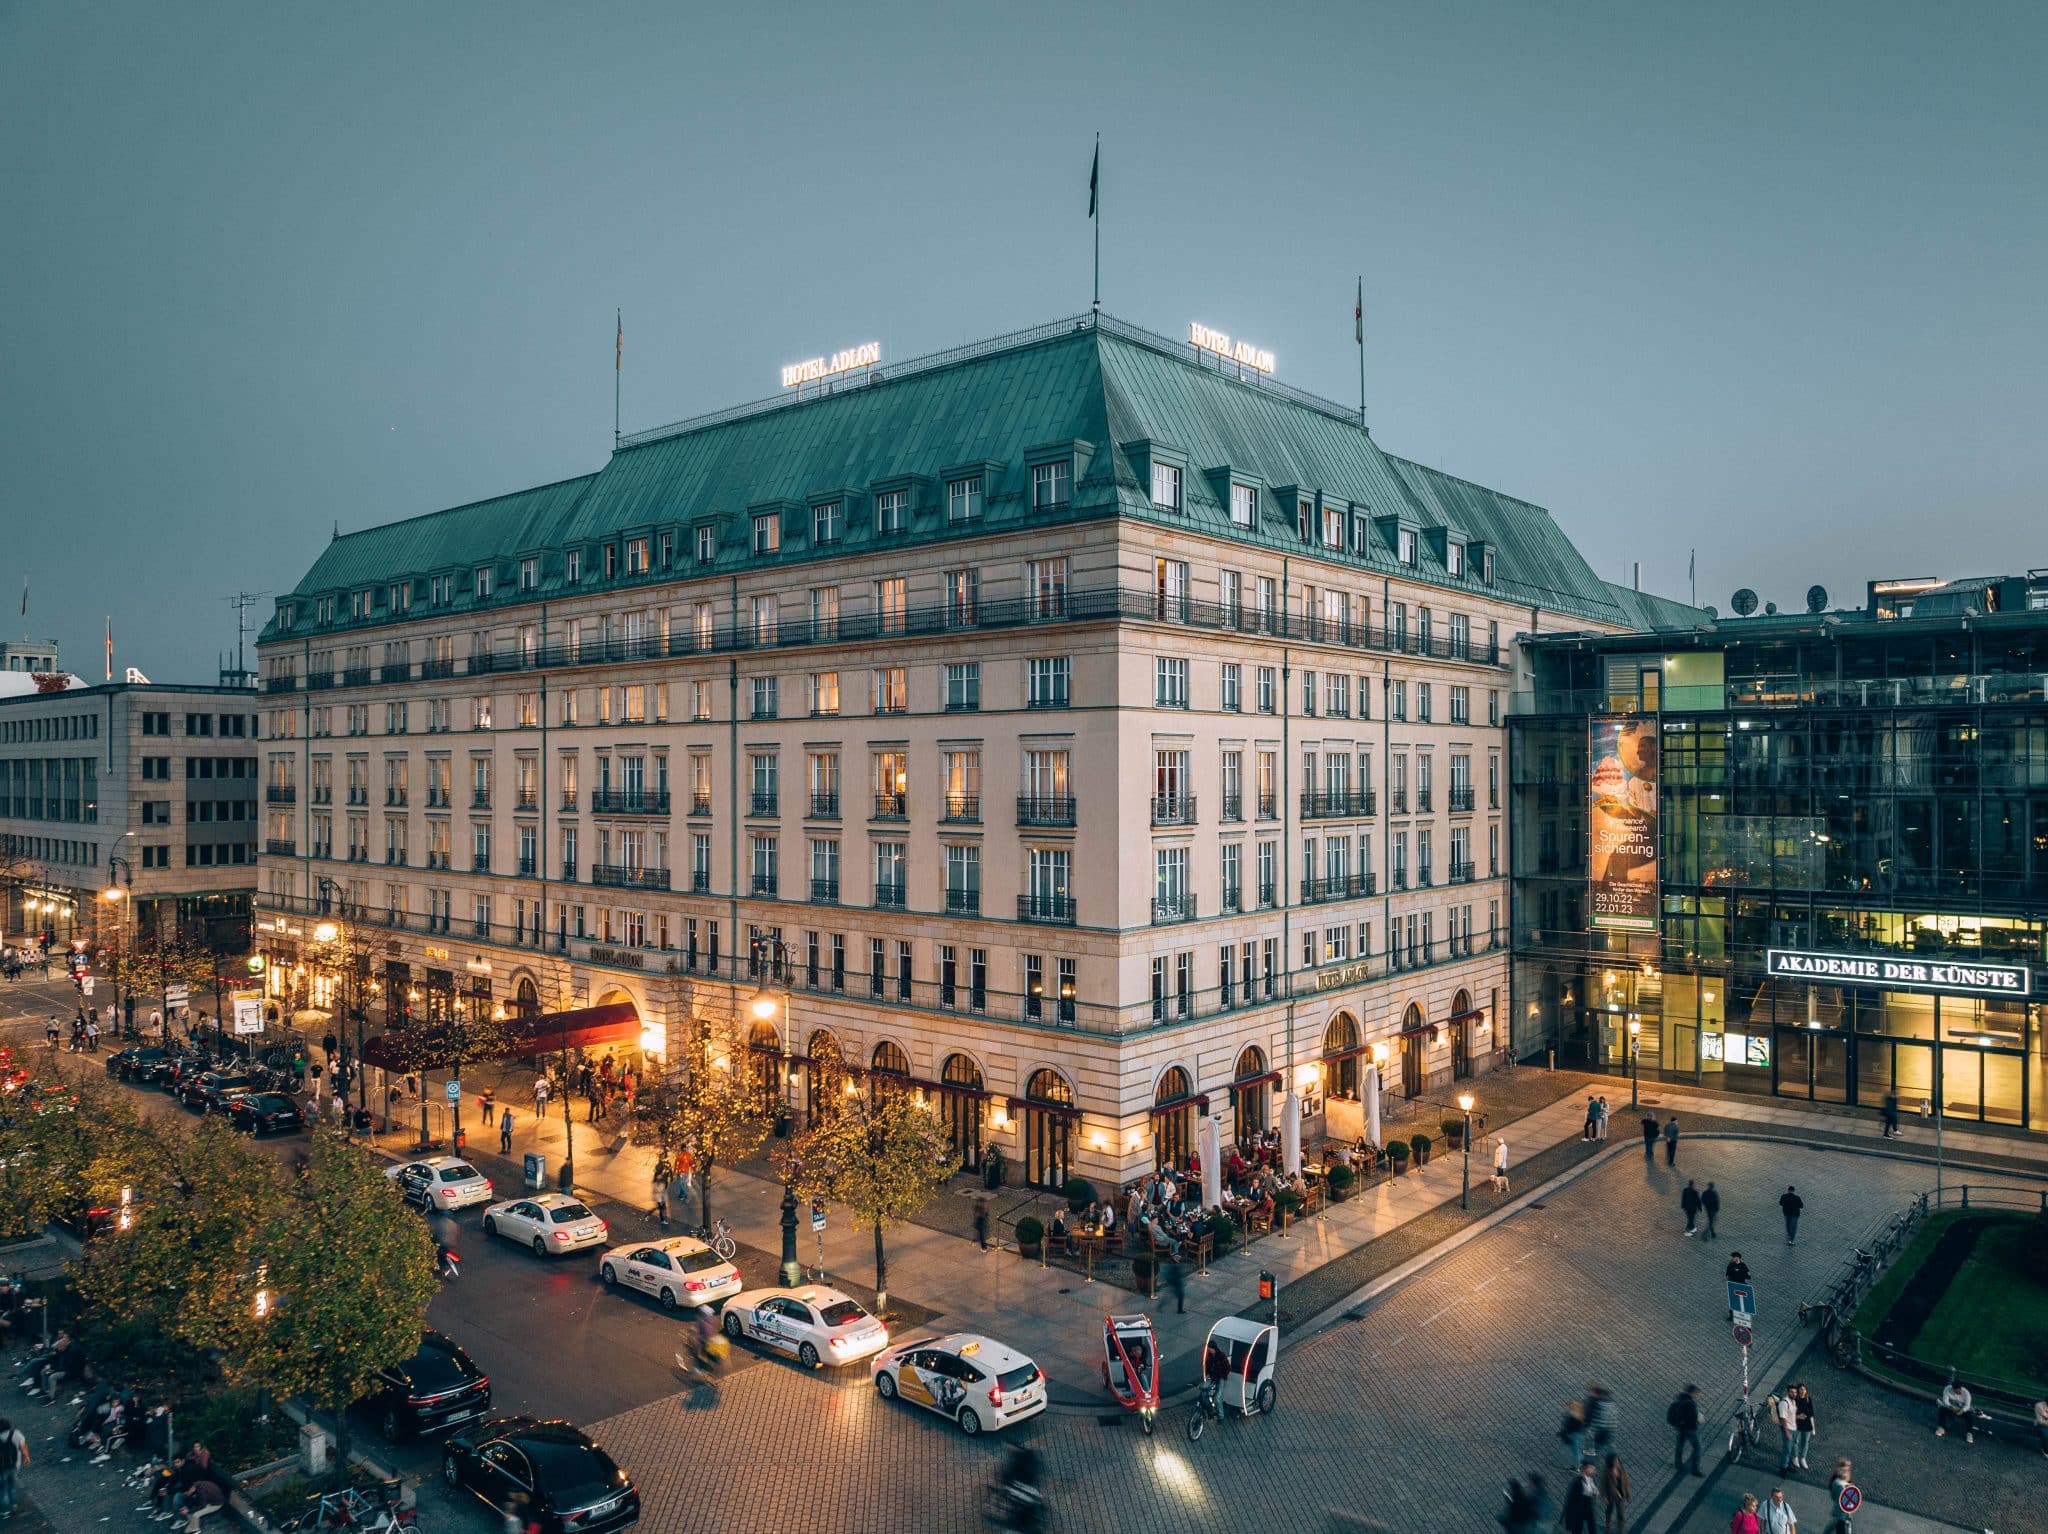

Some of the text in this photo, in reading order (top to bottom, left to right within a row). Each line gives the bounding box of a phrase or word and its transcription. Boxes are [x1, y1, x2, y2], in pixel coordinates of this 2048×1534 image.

[1190, 322, 1275, 374] HOTEL ADLON
[782, 341, 881, 387] HOTEL ADLON
[1599, 829, 1650, 843] Spuren-
[1595, 842, 1654, 858] sicherung
[1595, 903, 1633, 914] 22.01.23
[1777, 955, 2018, 988] AKADEMIE DER KÜNSTE
